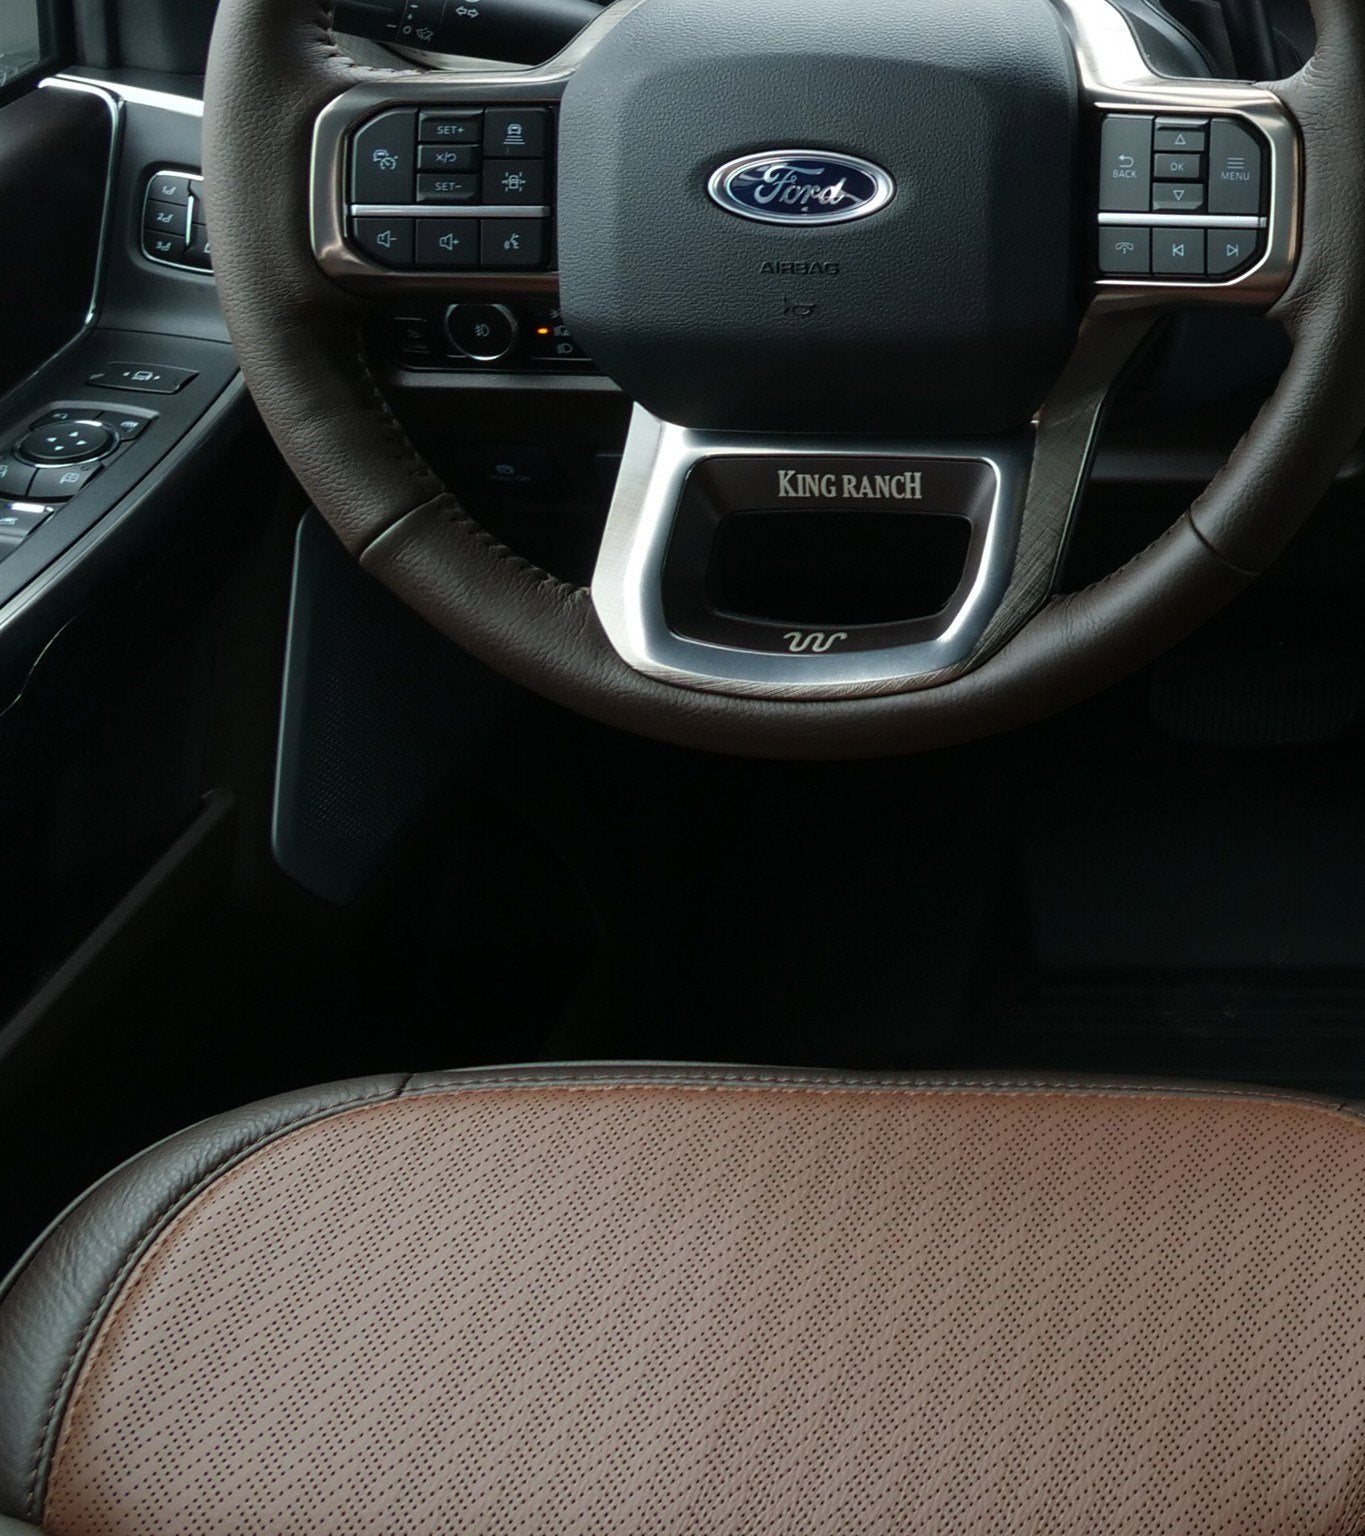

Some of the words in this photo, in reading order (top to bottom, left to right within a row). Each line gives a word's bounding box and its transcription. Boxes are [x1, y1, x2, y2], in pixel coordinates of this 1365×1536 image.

[436, 125, 465, 135] SET+
[1170, 162, 1184, 172] OK
[1112, 169, 1138, 179] BACK
[1220, 171, 1250, 182] MENU
[753, 162, 847, 207] Ford
[760, 262, 840, 275] AIRBAG
[777, 470, 837, 498] KING
[842, 472, 922, 500] RANCH
